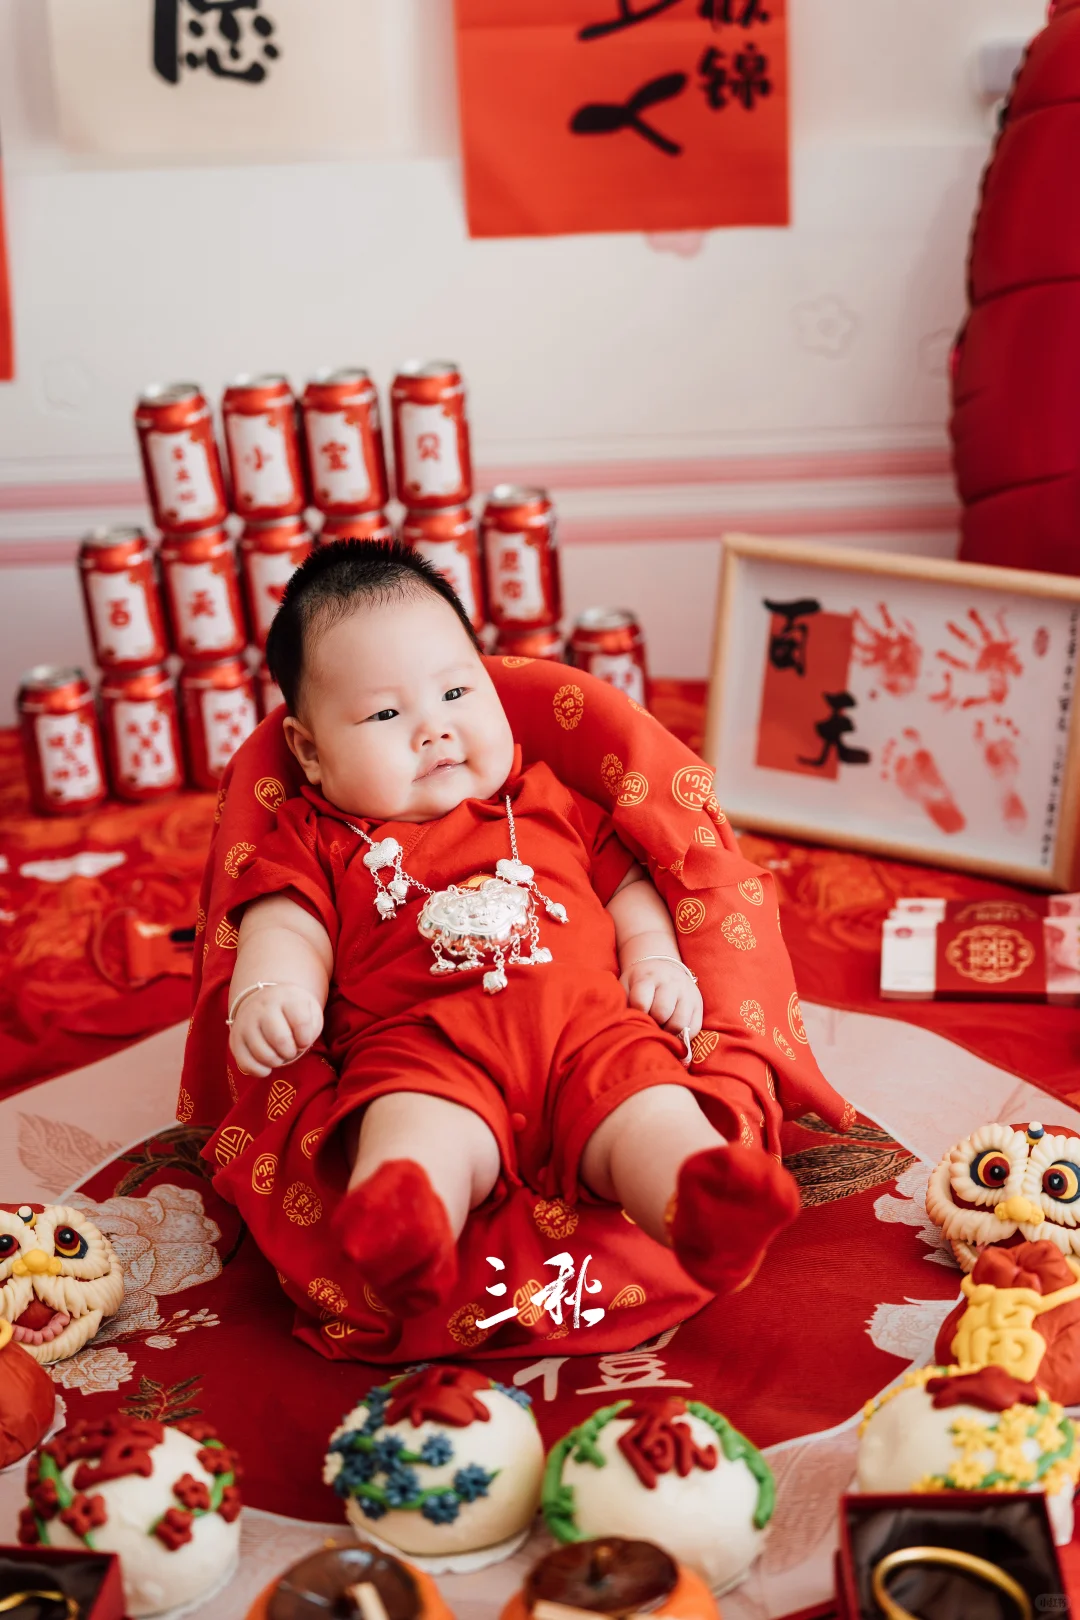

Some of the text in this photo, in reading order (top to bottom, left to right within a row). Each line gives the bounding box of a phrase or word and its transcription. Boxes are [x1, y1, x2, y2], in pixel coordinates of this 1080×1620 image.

[244, 445, 272, 473] 小
[320, 439, 348, 472] 宝
[417, 432, 441, 461] 贝
